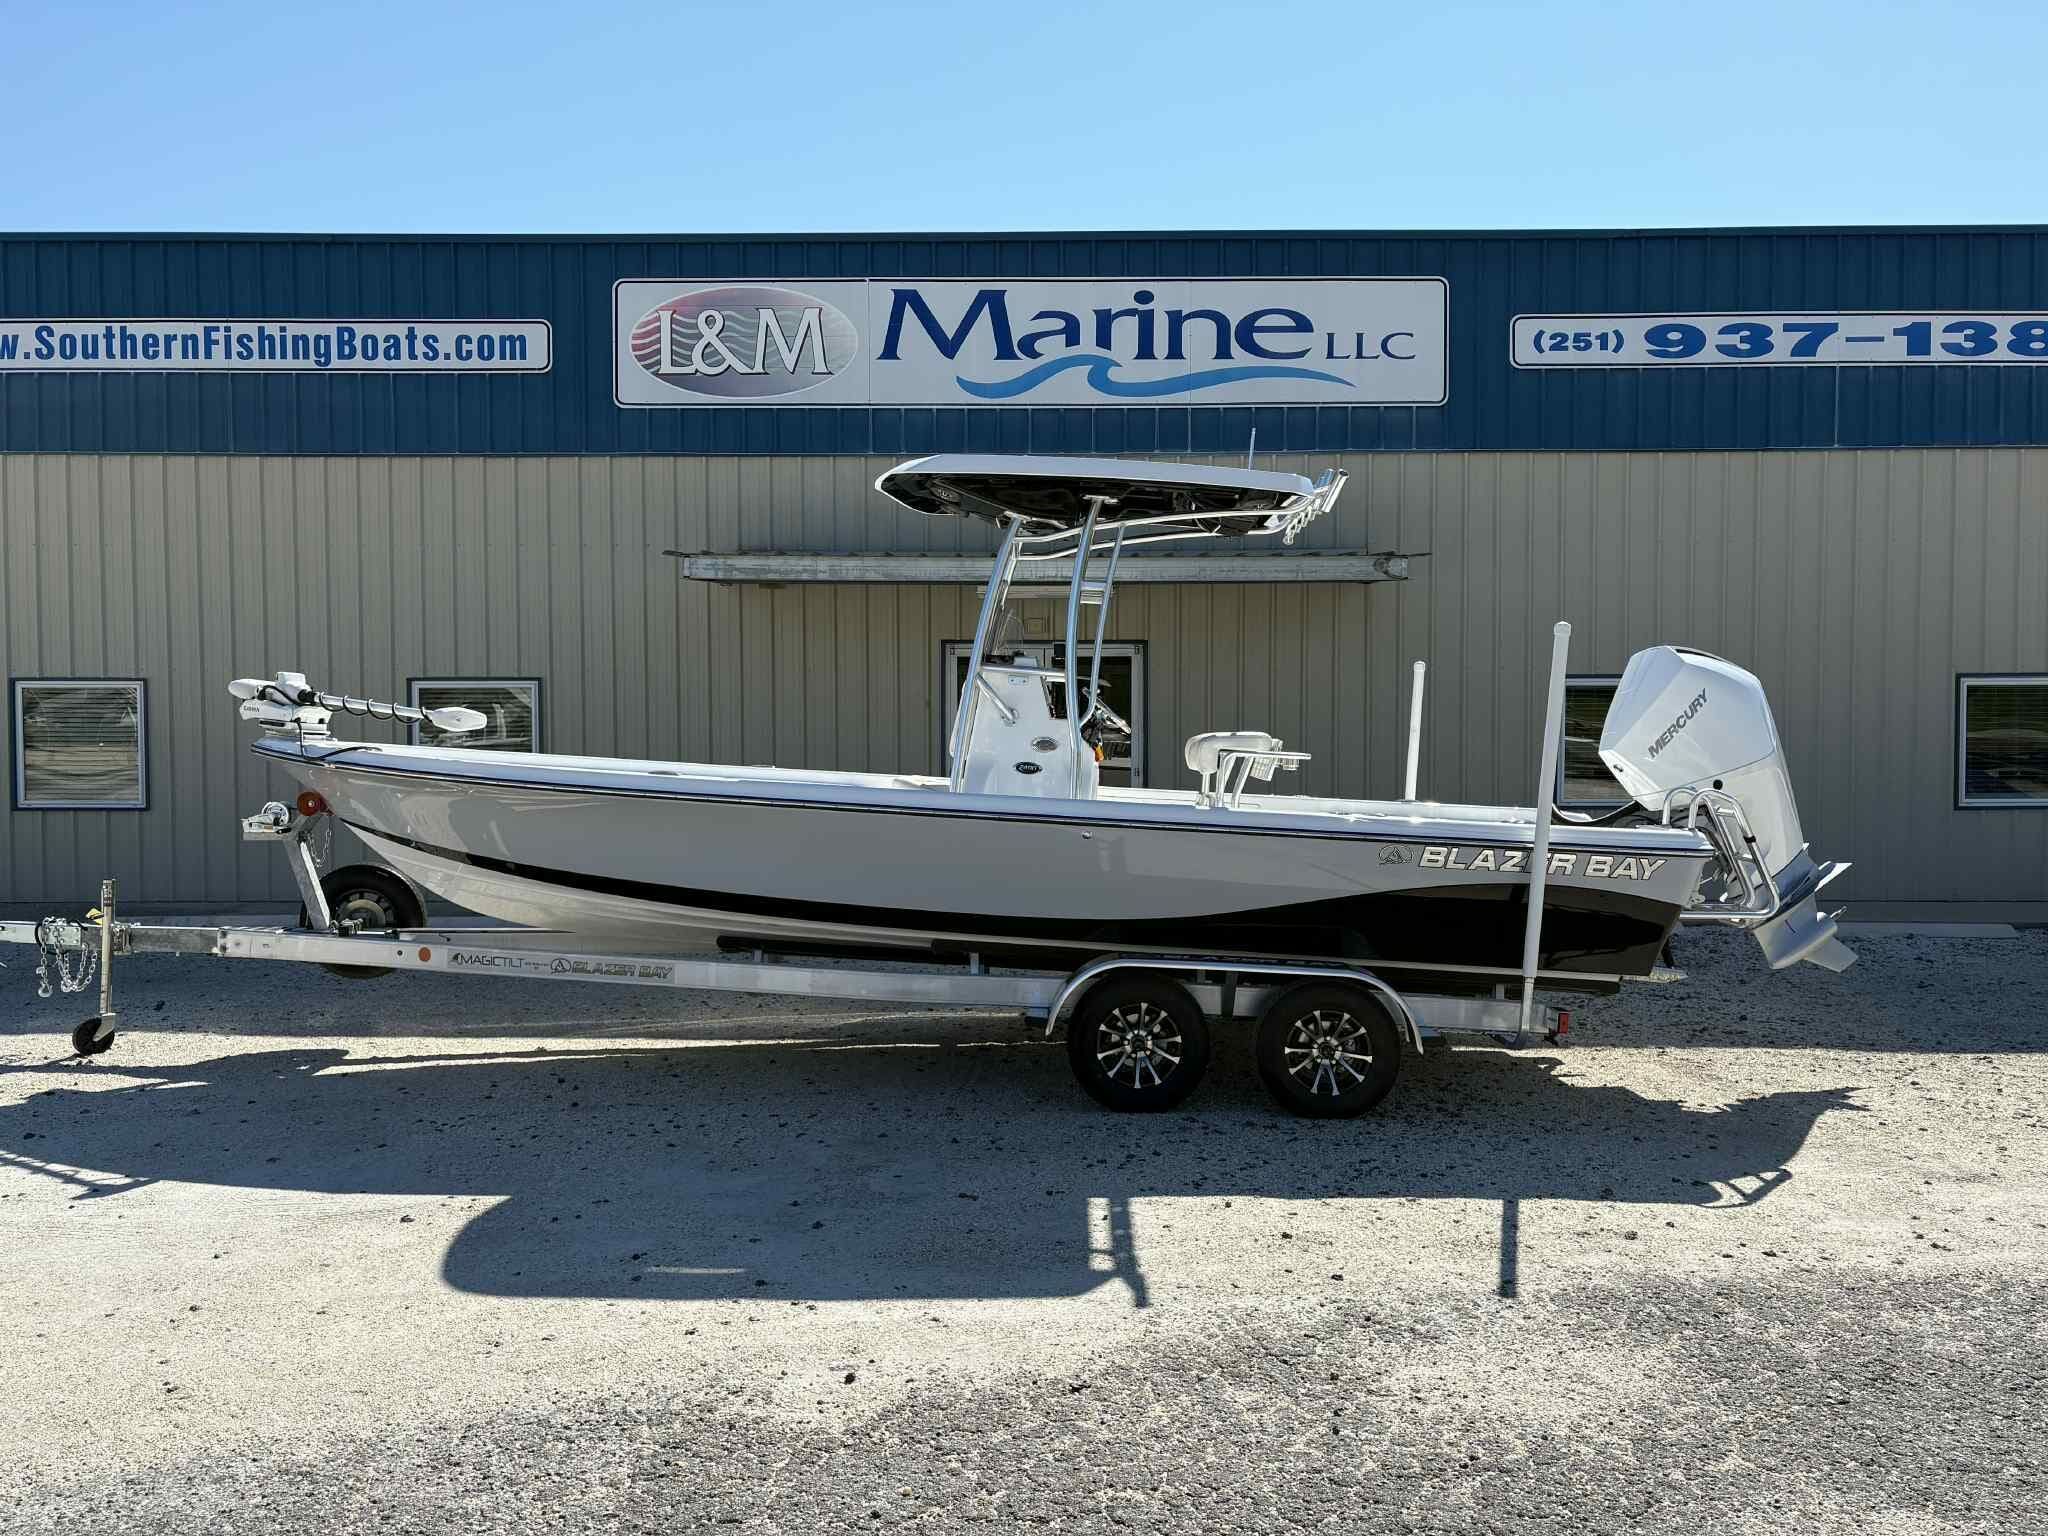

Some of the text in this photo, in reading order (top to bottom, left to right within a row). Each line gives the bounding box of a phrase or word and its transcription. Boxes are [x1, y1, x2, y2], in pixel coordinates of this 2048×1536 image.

[655, 289, 1416, 376] L&M Marine LLC
[1532, 320, 2048, 359] (251) 937-138
[1648, 688, 1707, 758] MERCURY
[1583, 855, 1667, 880] BAY
